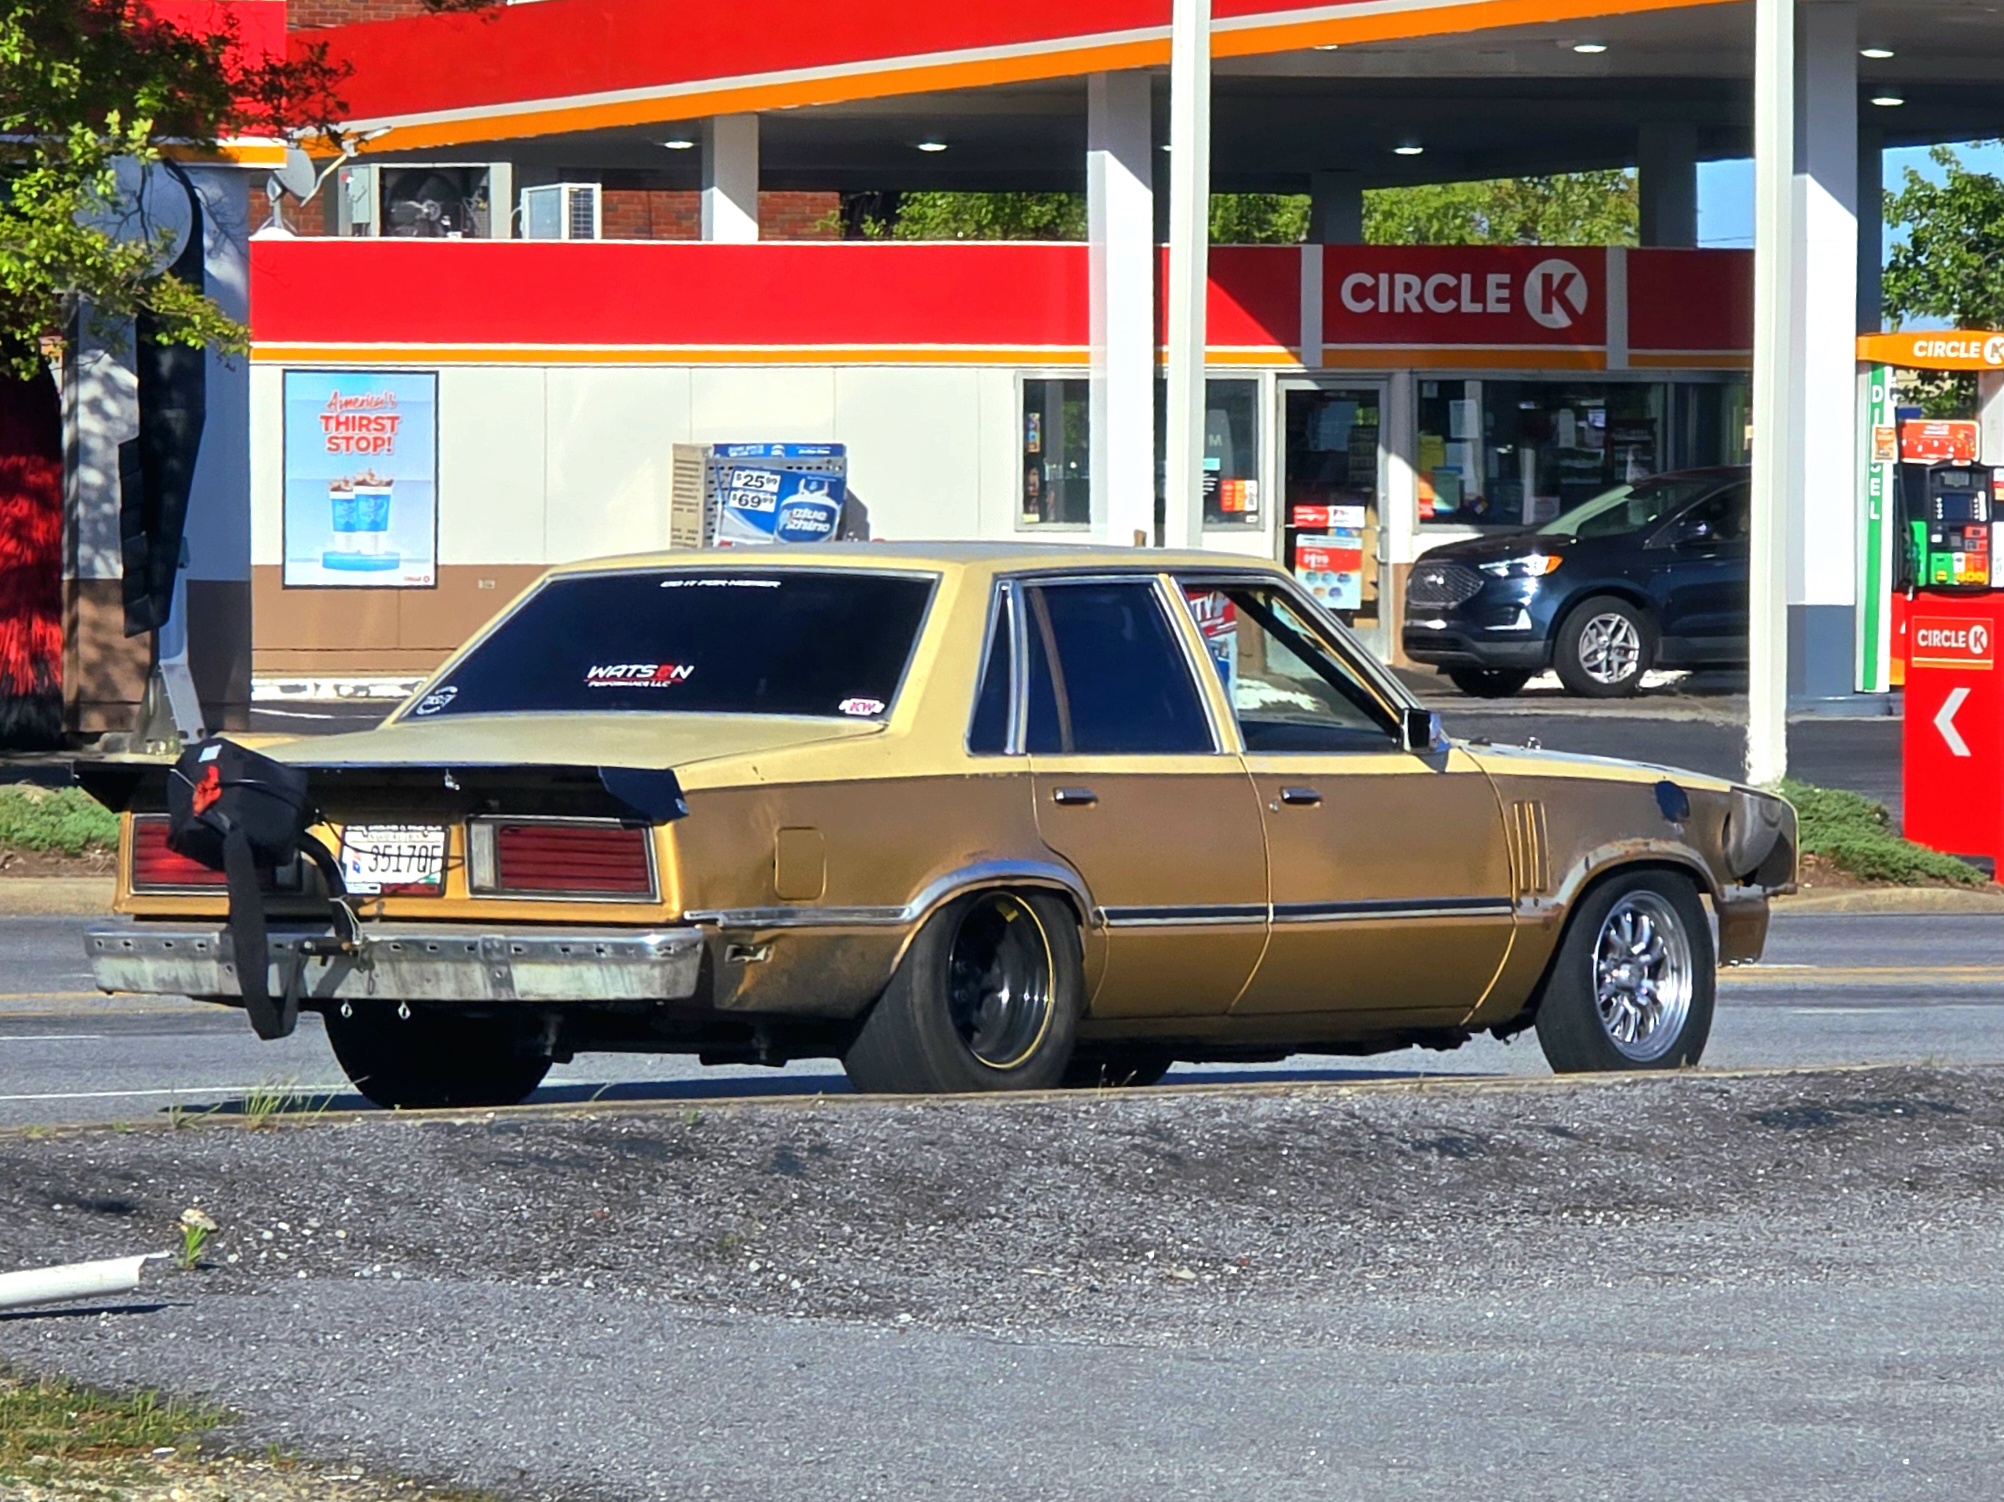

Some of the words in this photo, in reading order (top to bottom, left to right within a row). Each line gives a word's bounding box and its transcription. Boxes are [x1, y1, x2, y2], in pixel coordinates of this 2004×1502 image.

[1341, 273, 1511, 313] CIRCLE
[1534, 267, 1586, 324] K
[1913, 340, 1981, 358] CIRCLE
[326, 391, 398, 412] America's
[320, 415, 400, 433] THIRST
[327, 436, 393, 453] STOP!
[1870, 385, 1884, 520] DIEL
[1917, 629, 1966, 648] CIRCLE
[587, 664, 694, 680] WATSON
